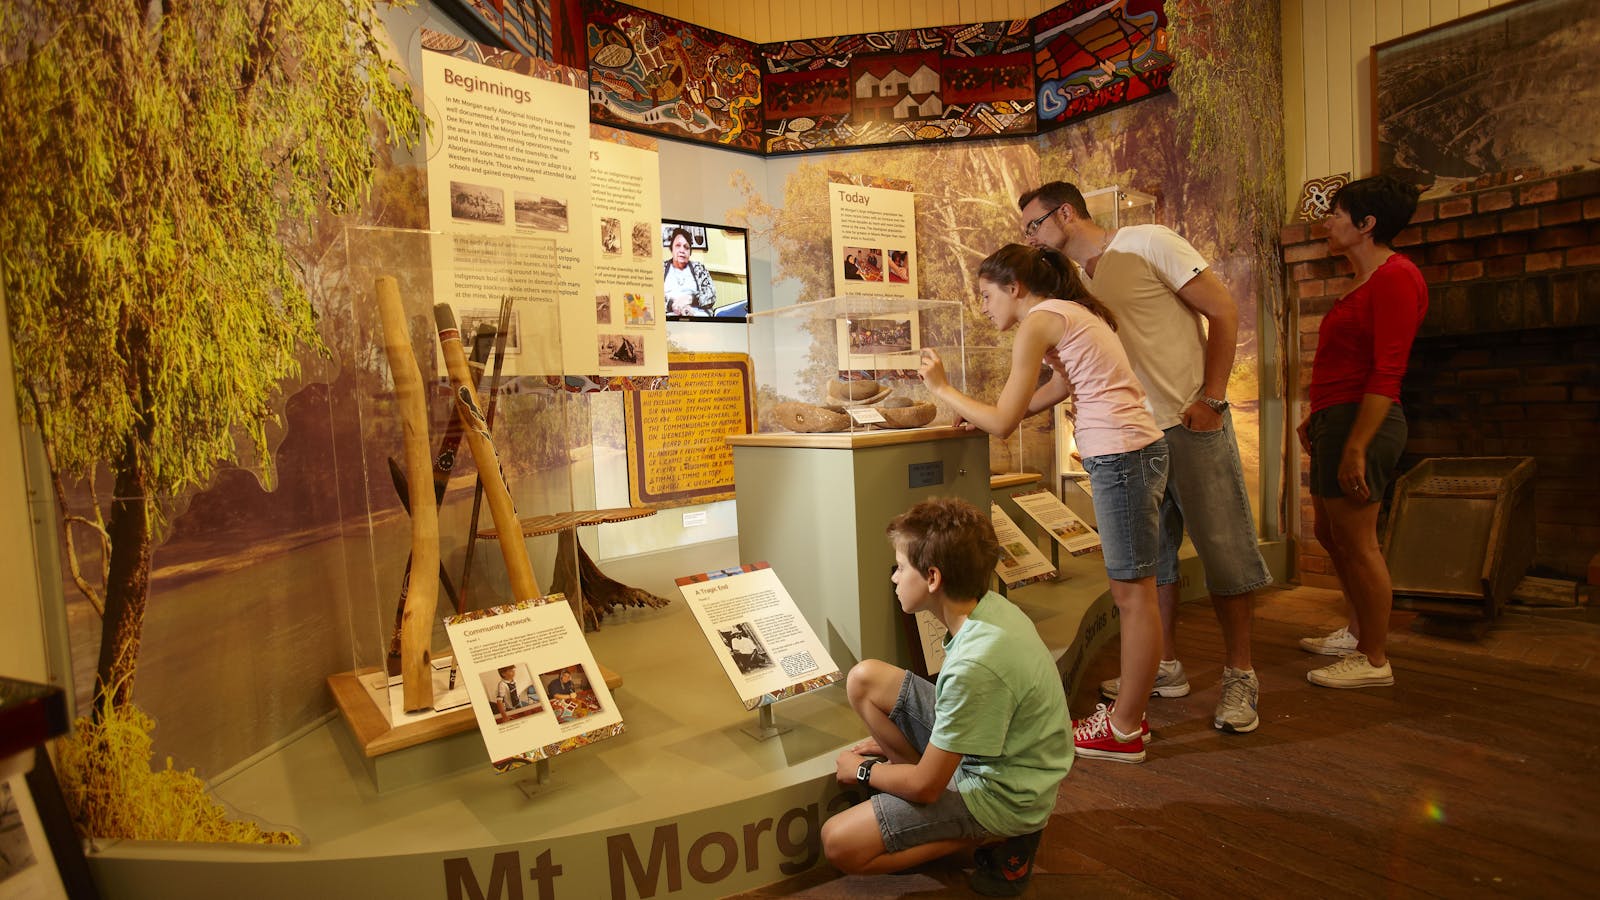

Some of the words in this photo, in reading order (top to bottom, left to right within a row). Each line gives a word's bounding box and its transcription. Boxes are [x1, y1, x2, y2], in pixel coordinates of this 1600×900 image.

[444, 68, 531, 104] Beginnings
[462, 99, 483, 109] Morgan
[499, 108, 525, 119] Aboriginal
[526, 114, 543, 122] history
[459, 109, 494, 120] documented.
[501, 118, 517, 126] group
[500, 126, 520, 134] Morgan
[522, 130, 537, 139] family
[448, 144, 478, 154] Aborigines
[470, 140, 507, 149] establishment
[507, 138, 524, 146] mining
[526, 141, 552, 150] operations
[448, 153, 471, 162] Western
[838, 191, 870, 206] Today
[455, 282, 482, 290] becoming
[664, 422, 709, 431] COMMONWEALTH
[464, 624, 504, 637] Community
[505, 617, 531, 627] Artwork
[443, 848, 563, 900] Mt
[606, 790, 862, 899] Morg
